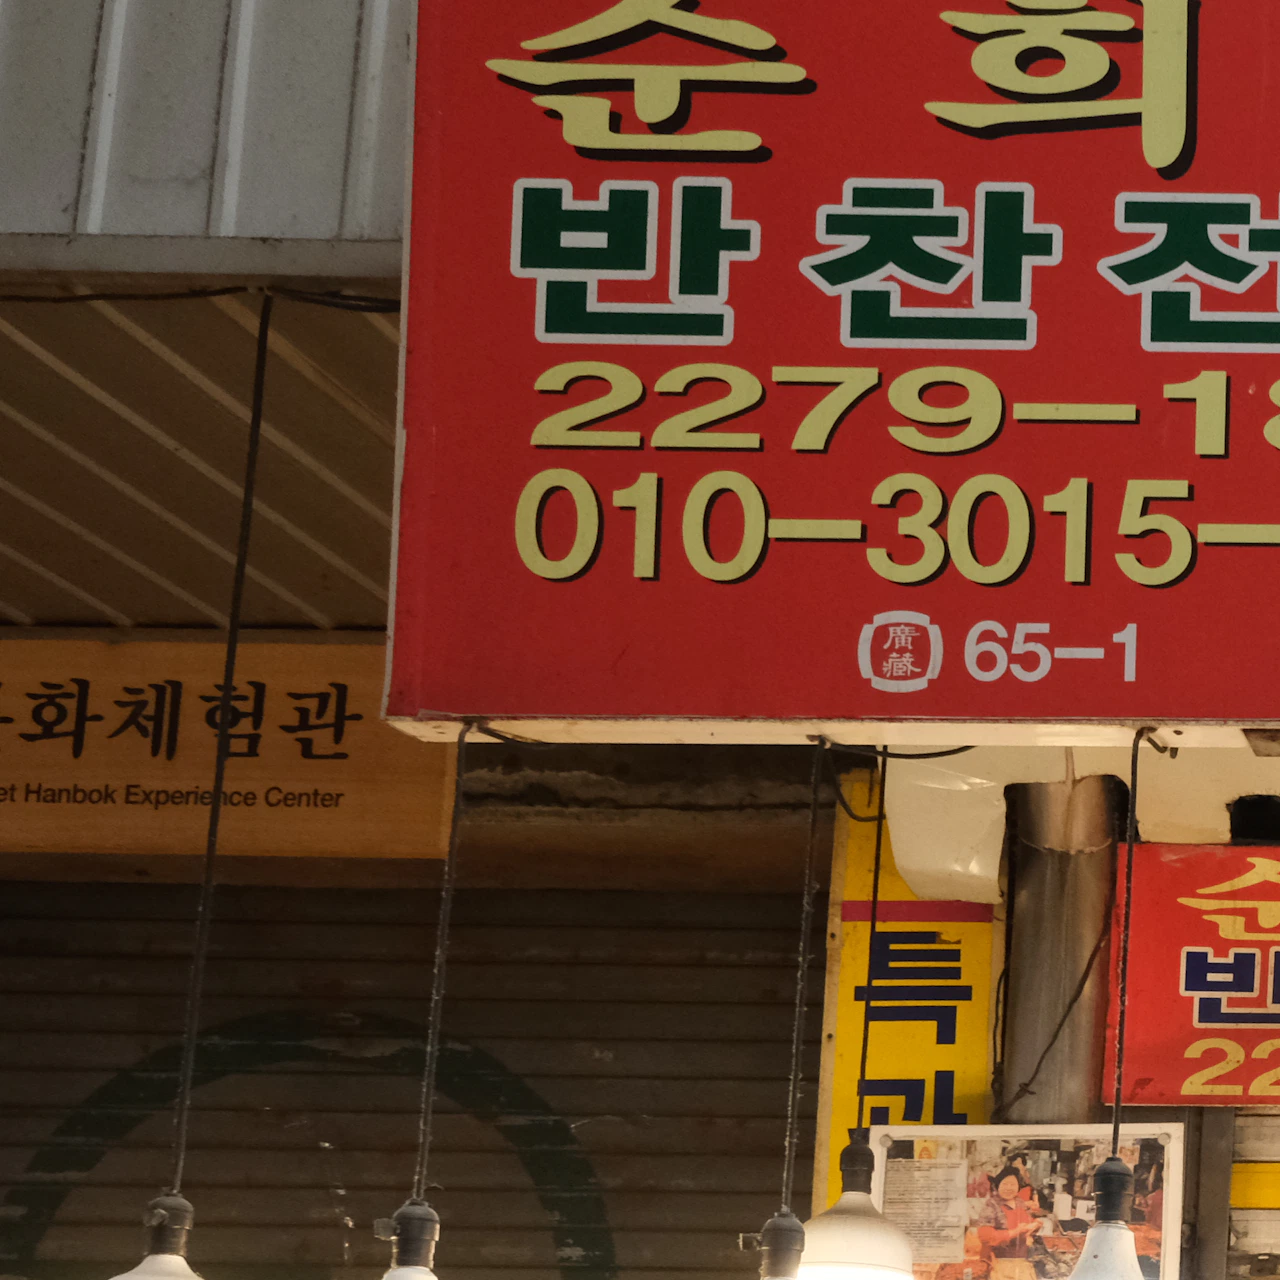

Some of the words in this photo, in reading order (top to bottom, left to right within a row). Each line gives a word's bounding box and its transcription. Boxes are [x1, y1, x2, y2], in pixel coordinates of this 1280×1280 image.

[963, 621, 1138, 685] 65-1
[0, 678, 364, 761] 화체험관
[24, 783, 117, 804] Hanbok
[124, 784, 258, 809] Experience
[264, 787, 345, 808] Center
